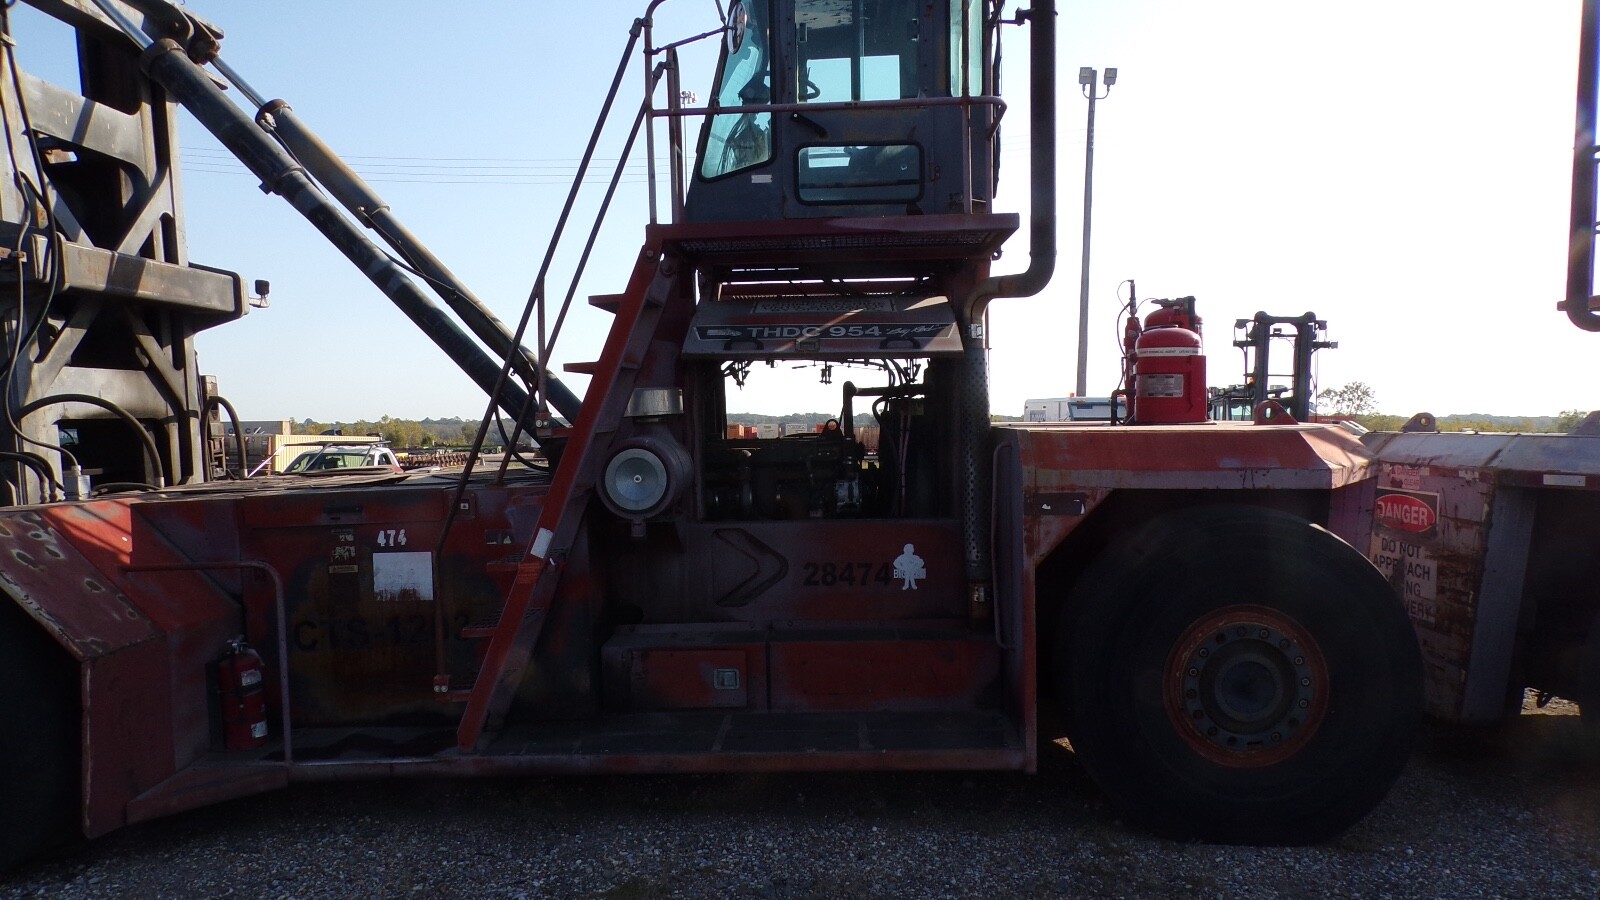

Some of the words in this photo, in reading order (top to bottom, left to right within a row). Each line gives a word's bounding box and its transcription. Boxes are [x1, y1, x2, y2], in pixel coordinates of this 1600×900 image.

[747, 326, 819, 338] THDC
[830, 326, 882, 338] 954
[1377, 500, 1428, 526] DANGER
[377, 529, 407, 547] 474
[1381, 537, 1396, 554] DO
[1399, 541, 1422, 559] NOT
[803, 562, 892, 587] 28474
